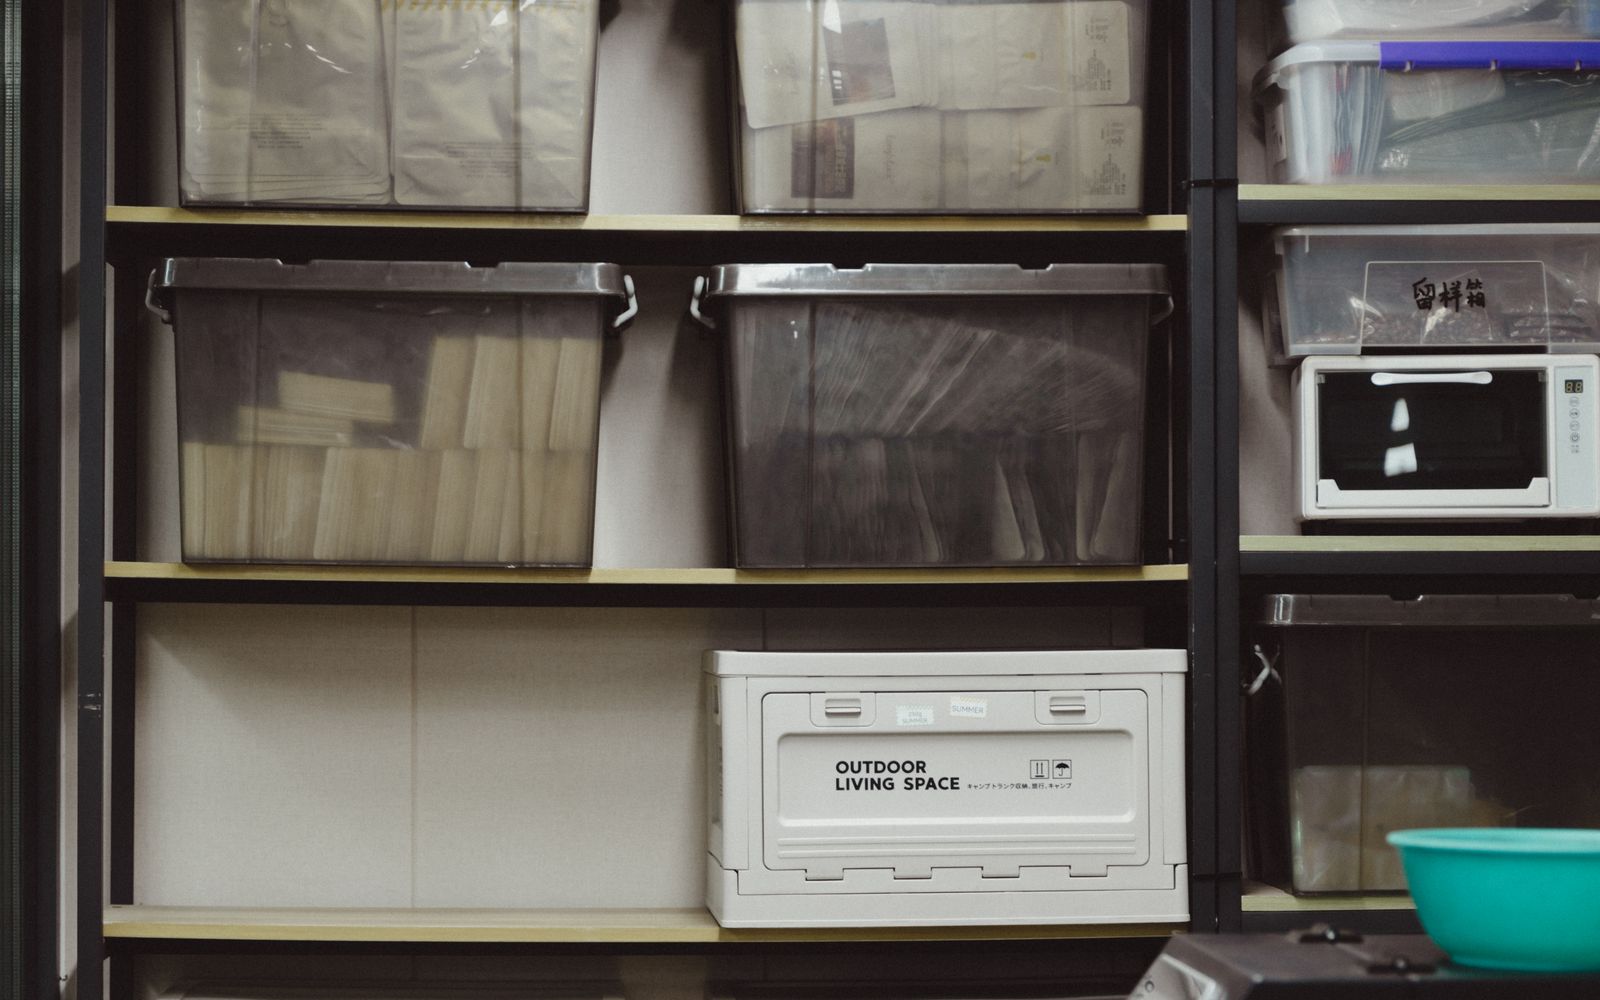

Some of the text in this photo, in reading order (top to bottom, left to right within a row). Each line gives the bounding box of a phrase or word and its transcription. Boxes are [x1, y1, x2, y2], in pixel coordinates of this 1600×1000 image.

[1412, 277, 1486, 312] 留样箱
[835, 760, 927, 774] OUTDOOR
[835, 777, 960, 791] LIVING SPACE
